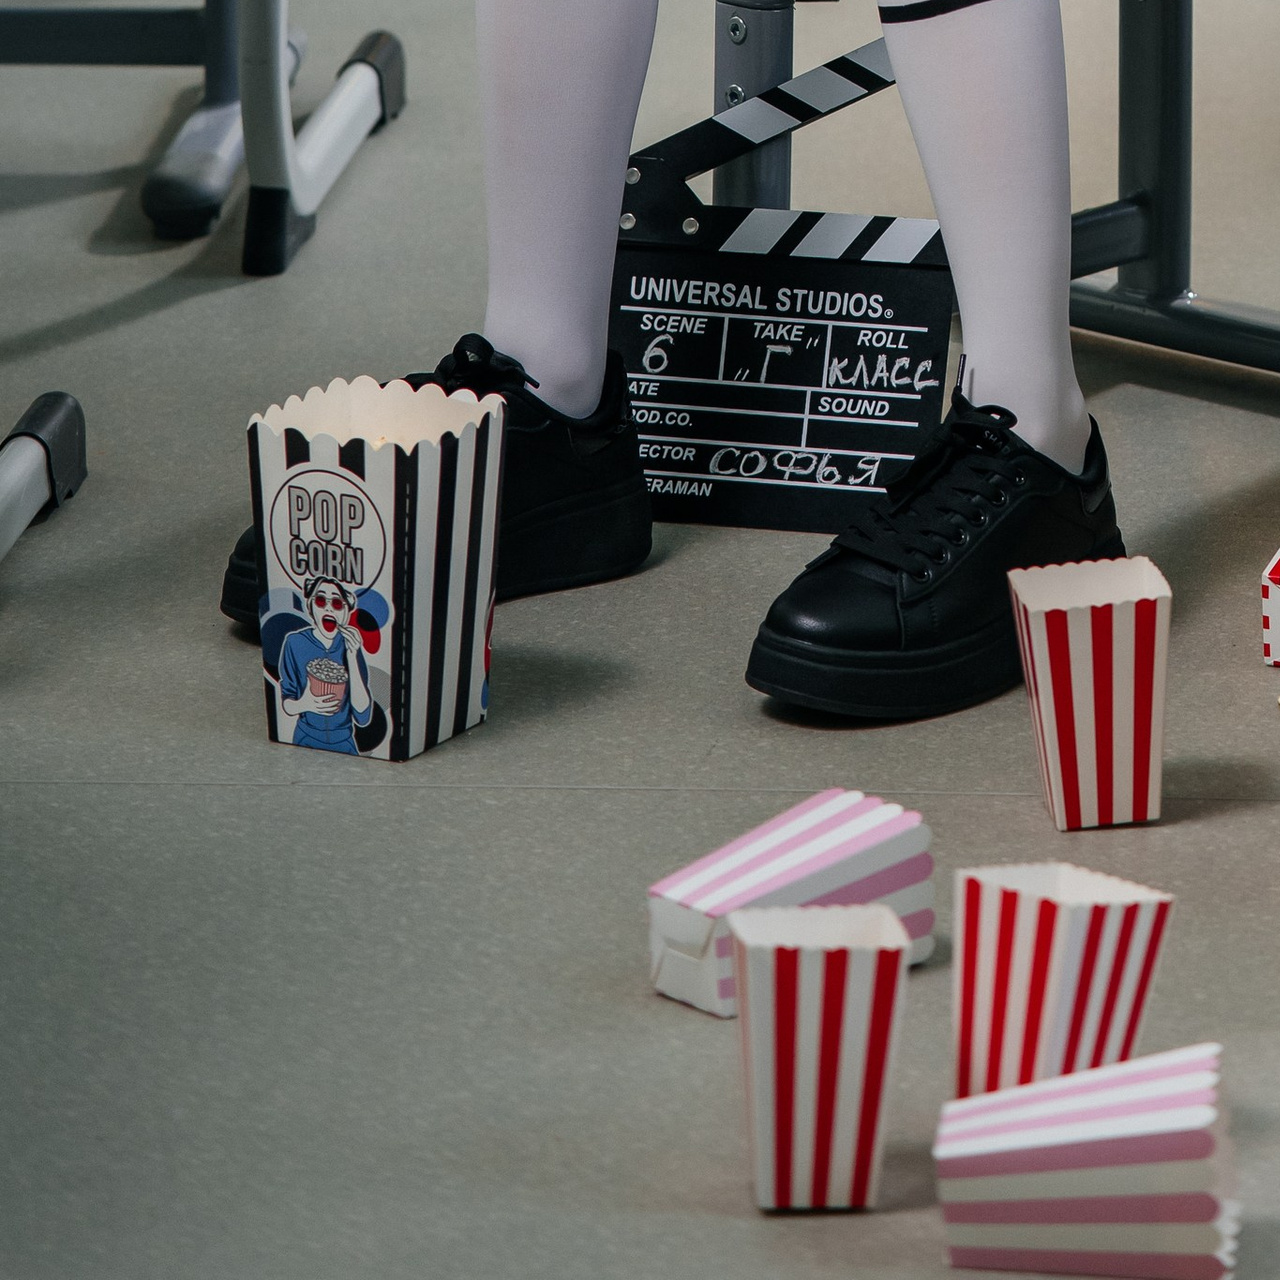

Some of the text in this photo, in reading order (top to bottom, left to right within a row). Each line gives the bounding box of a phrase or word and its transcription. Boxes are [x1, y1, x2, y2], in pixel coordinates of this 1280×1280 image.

[630, 276, 767, 310] UNIVERSAL
[640, 314, 708, 334] SCENE
[753, 322, 805, 341] TAKE
[857, 330, 909, 349] ROLL
[642, 334, 674, 373] 6
[828, 354, 939, 391] КЛАСС
[629, 381, 660, 396] ATE
[818, 396, 890, 416] SOUND
[632, 409, 692, 426] OD.CO.
[639, 444, 696, 461] ECTOR
[645, 478, 713, 497] RAMAN
[288, 485, 365, 545] POP
[289, 537, 363, 586] CORN
